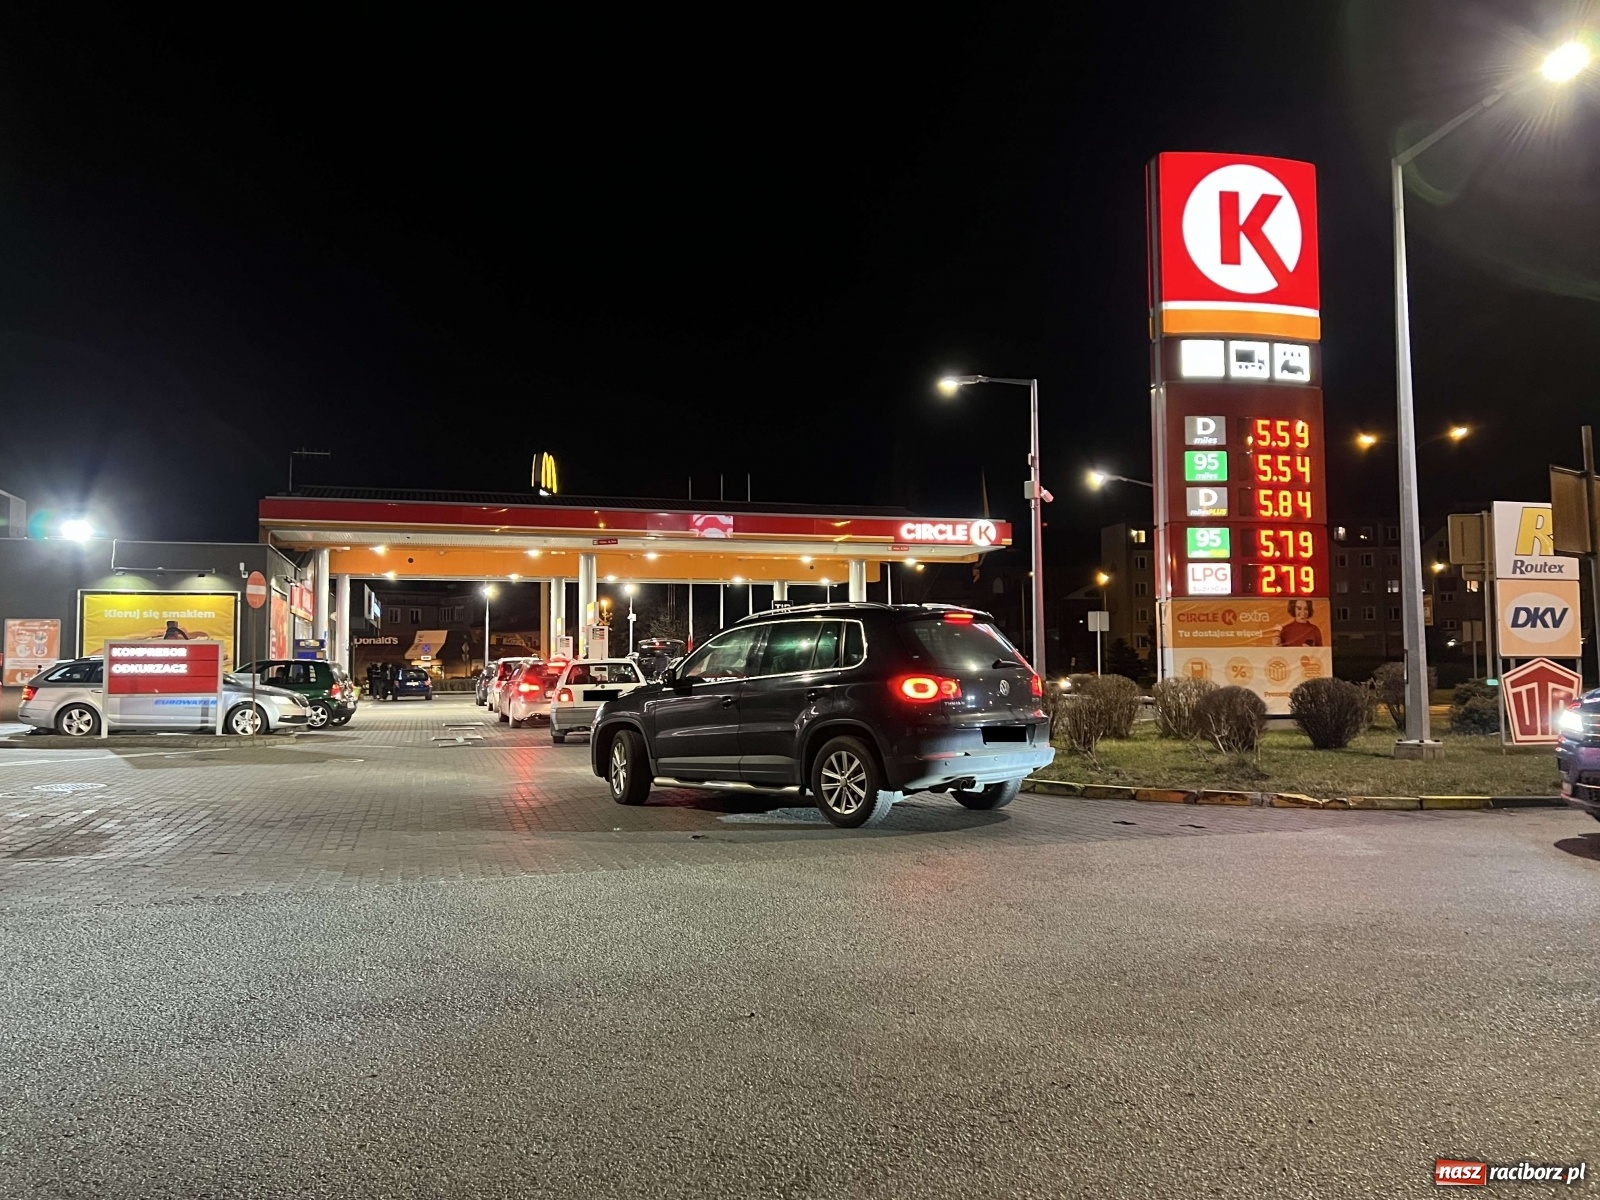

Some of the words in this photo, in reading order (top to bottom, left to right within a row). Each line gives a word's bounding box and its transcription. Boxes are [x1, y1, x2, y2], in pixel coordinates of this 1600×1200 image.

[1215, 188, 1294, 289] K
[1196, 417, 1216, 435] D
[1257, 419, 1309, 448] 5.59
[1193, 453, 1219, 470] 95
[1258, 454, 1311, 483] 5.54
[1195, 472, 1219, 480] miles
[1198, 489, 1218, 506] D
[1259, 489, 1312, 518] 5.84
[900, 522, 968, 540] CIRCLE
[1195, 529, 1222, 547] 95
[1515, 506, 1554, 556] R
[1260, 529, 1313, 558] 5.79
[1191, 567, 1228, 582] LPG
[1511, 559, 1565, 575] Routex
[1261, 565, 1315, 593] 2.79
[104, 609, 140, 620] Kieruj
[142, 609, 160, 620] się
[162, 609, 216, 619] smakiem
[1177, 612, 1219, 623] CIRCLE
[1223, 610, 1236, 625] K
[1239, 610, 1270, 623] extra
[1510, 606, 1569, 629] DKV
[1178, 629, 1190, 638] Tu
[1192, 629, 1235, 638] dostajesz
[1236, 629, 1263, 638] więcej
[111, 647, 188, 658] KOMPRESOR
[111, 663, 188, 674] ODKURZACZ
